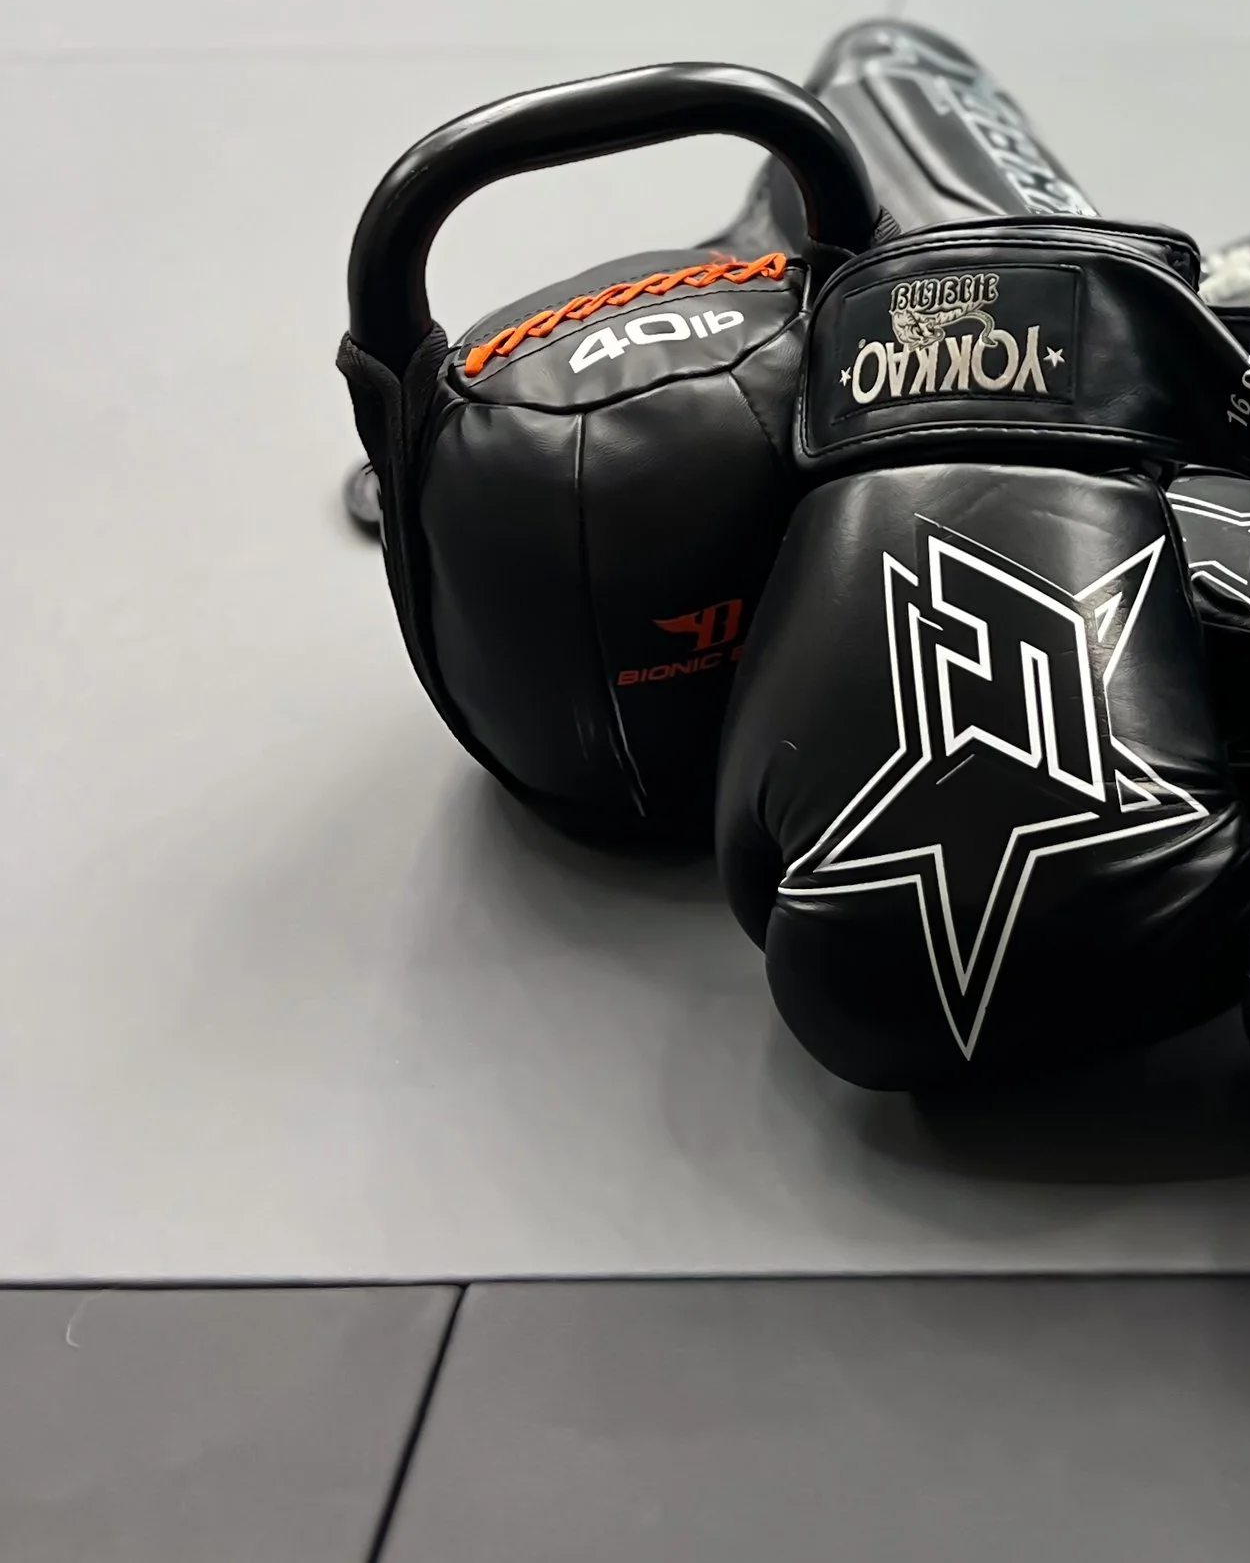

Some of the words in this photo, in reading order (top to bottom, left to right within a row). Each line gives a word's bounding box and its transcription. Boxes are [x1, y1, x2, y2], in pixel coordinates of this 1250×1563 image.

[852, 325, 1049, 404] YOKKAO
[1226, 394, 1250, 427] 16
[616, 652, 723, 686] BIONIC
